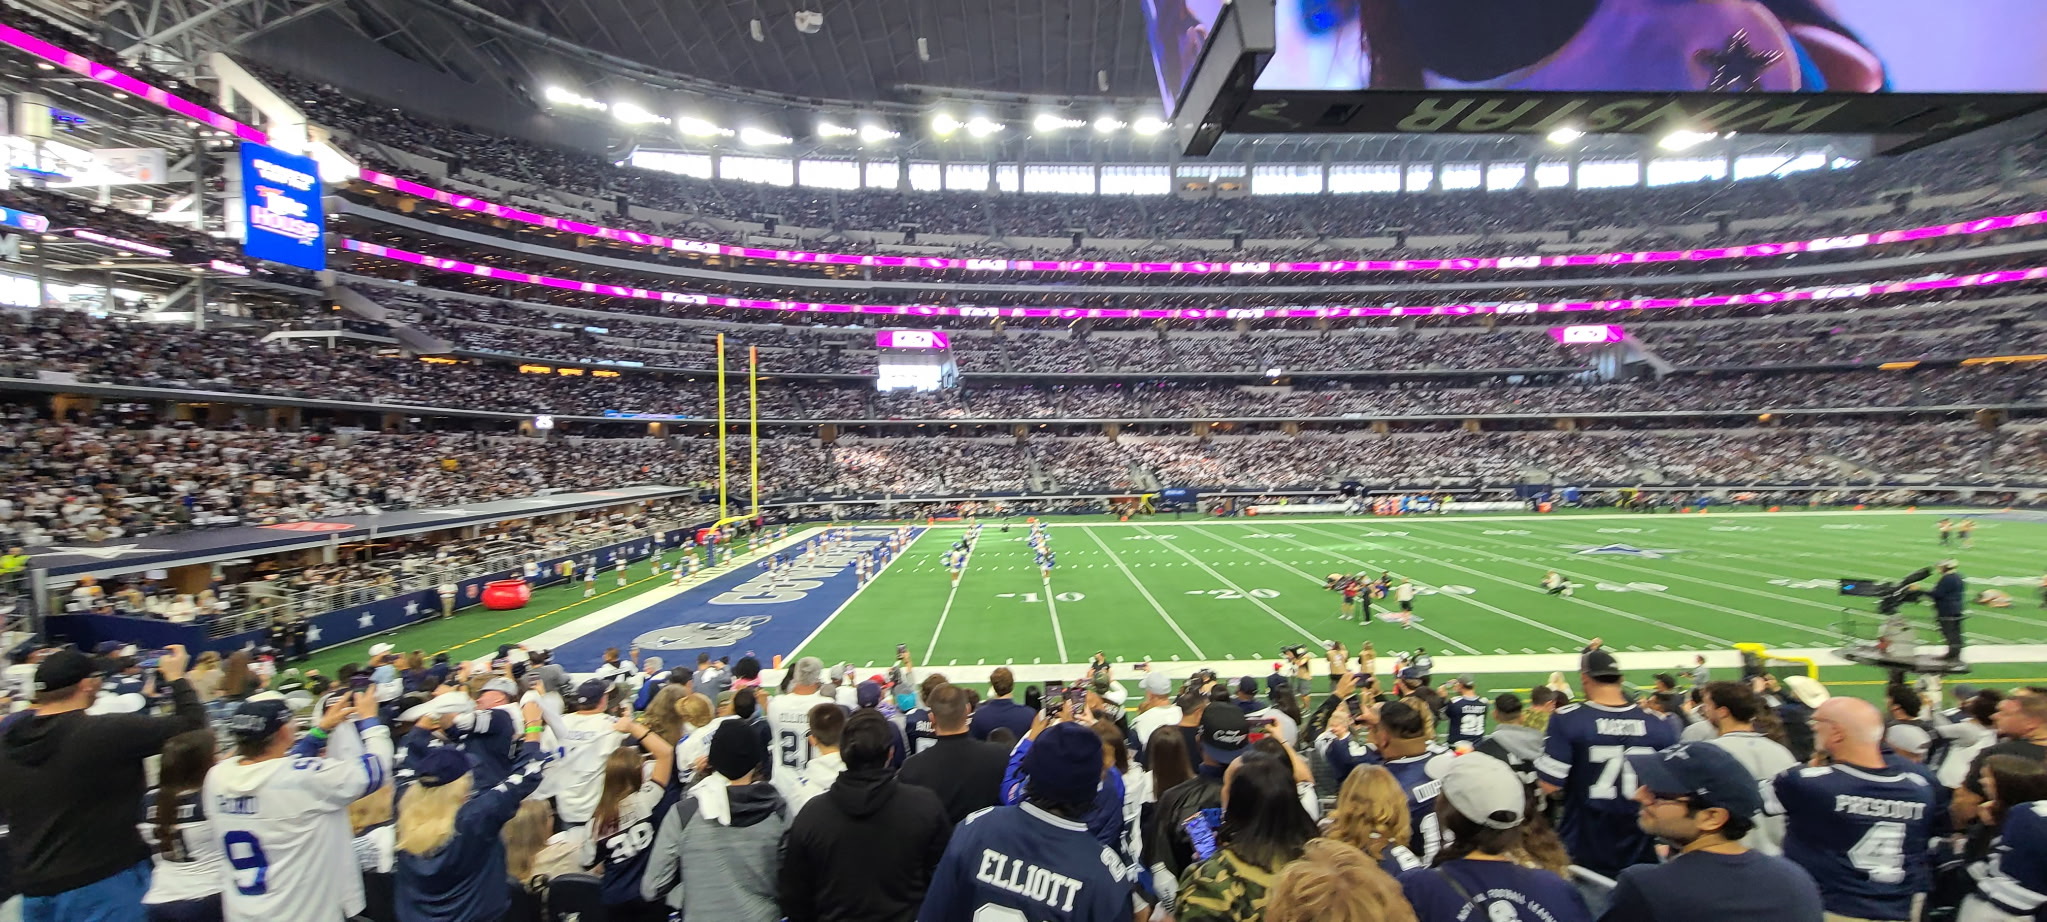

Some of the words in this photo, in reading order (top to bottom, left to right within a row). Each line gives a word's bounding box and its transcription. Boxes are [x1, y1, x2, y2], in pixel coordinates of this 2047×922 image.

[1398, 100, 1851, 131] WINSTAR
[1019, 591, 1086, 603] 10
[1207, 588, 1280, 600] 20
[781, 729, 811, 769] 21
[1834, 794, 1927, 820] PRESCOTT
[224, 830, 269, 896] 9
[1847, 821, 1906, 884] 4
[976, 848, 1083, 913] ELLIOTT
